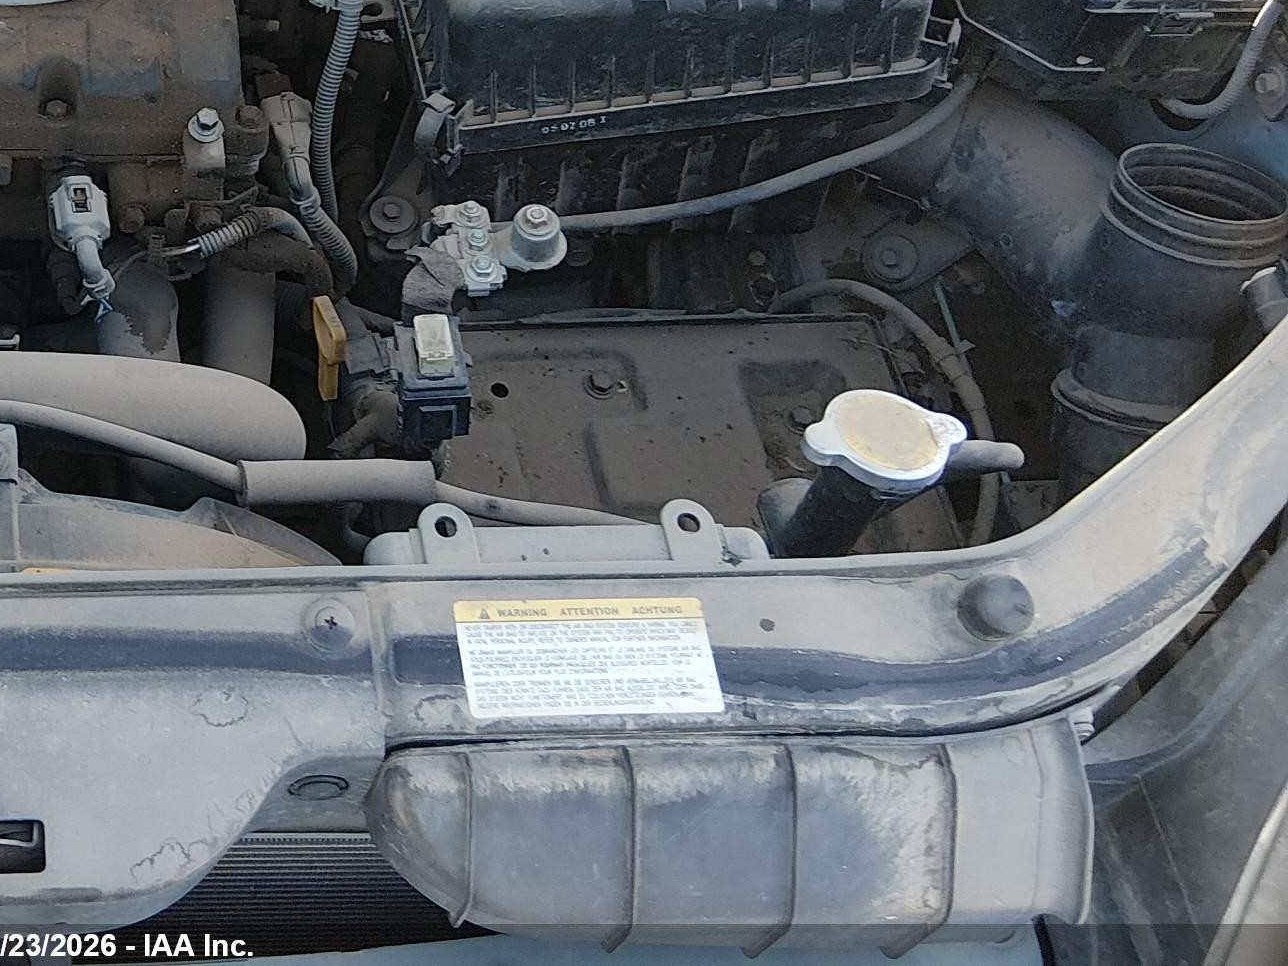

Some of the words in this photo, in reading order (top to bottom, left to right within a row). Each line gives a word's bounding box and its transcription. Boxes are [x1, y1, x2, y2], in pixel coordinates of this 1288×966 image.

[496, 608, 548, 617] WARNING
[559, 607, 619, 616] ATTENTION
[631, 605, 683, 616] ACHTUNG
